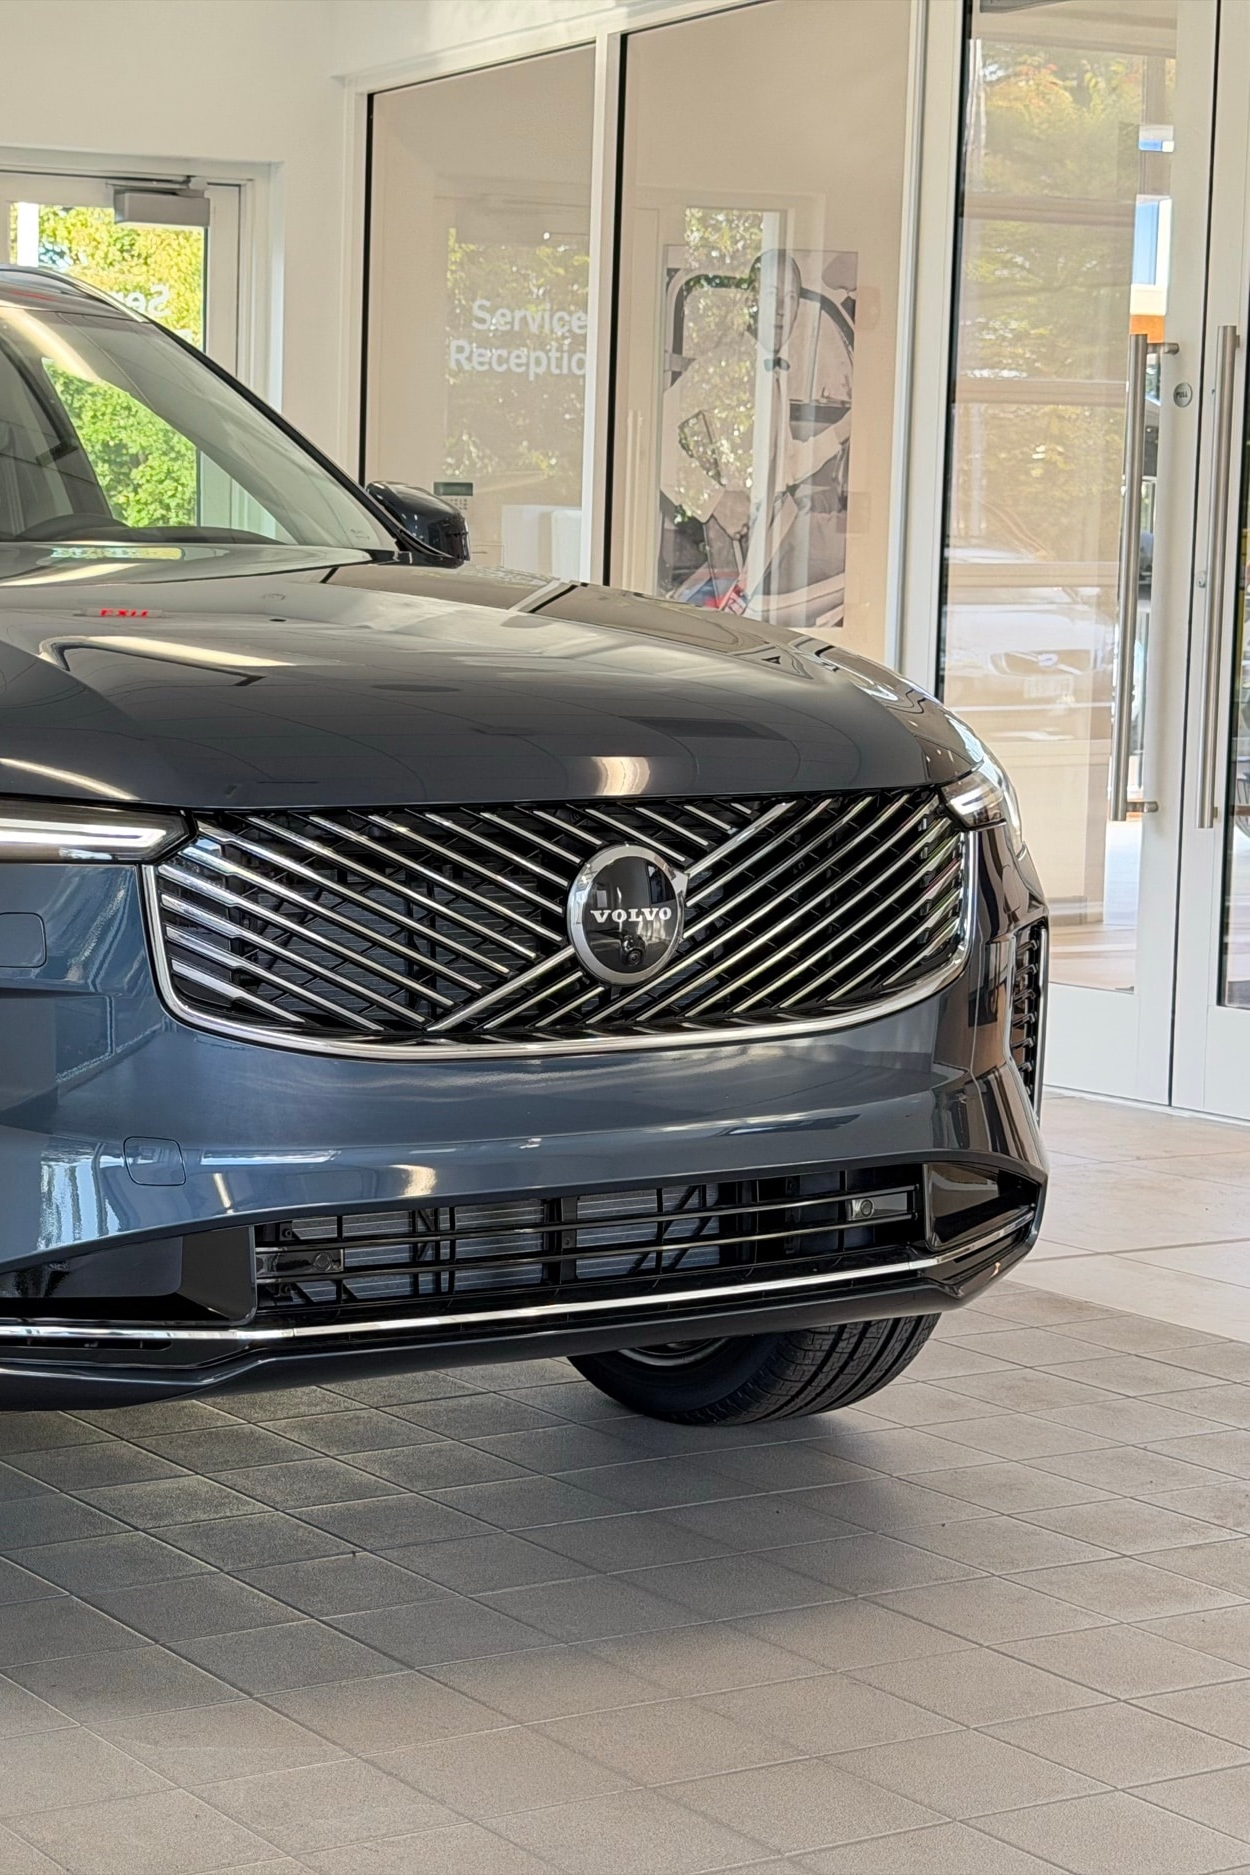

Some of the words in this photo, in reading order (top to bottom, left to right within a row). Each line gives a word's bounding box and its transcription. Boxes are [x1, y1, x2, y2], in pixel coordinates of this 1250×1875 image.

[471, 298, 588, 335] Service
[449, 338, 587, 382] Receptio
[590, 906, 672, 924] VOLVO
